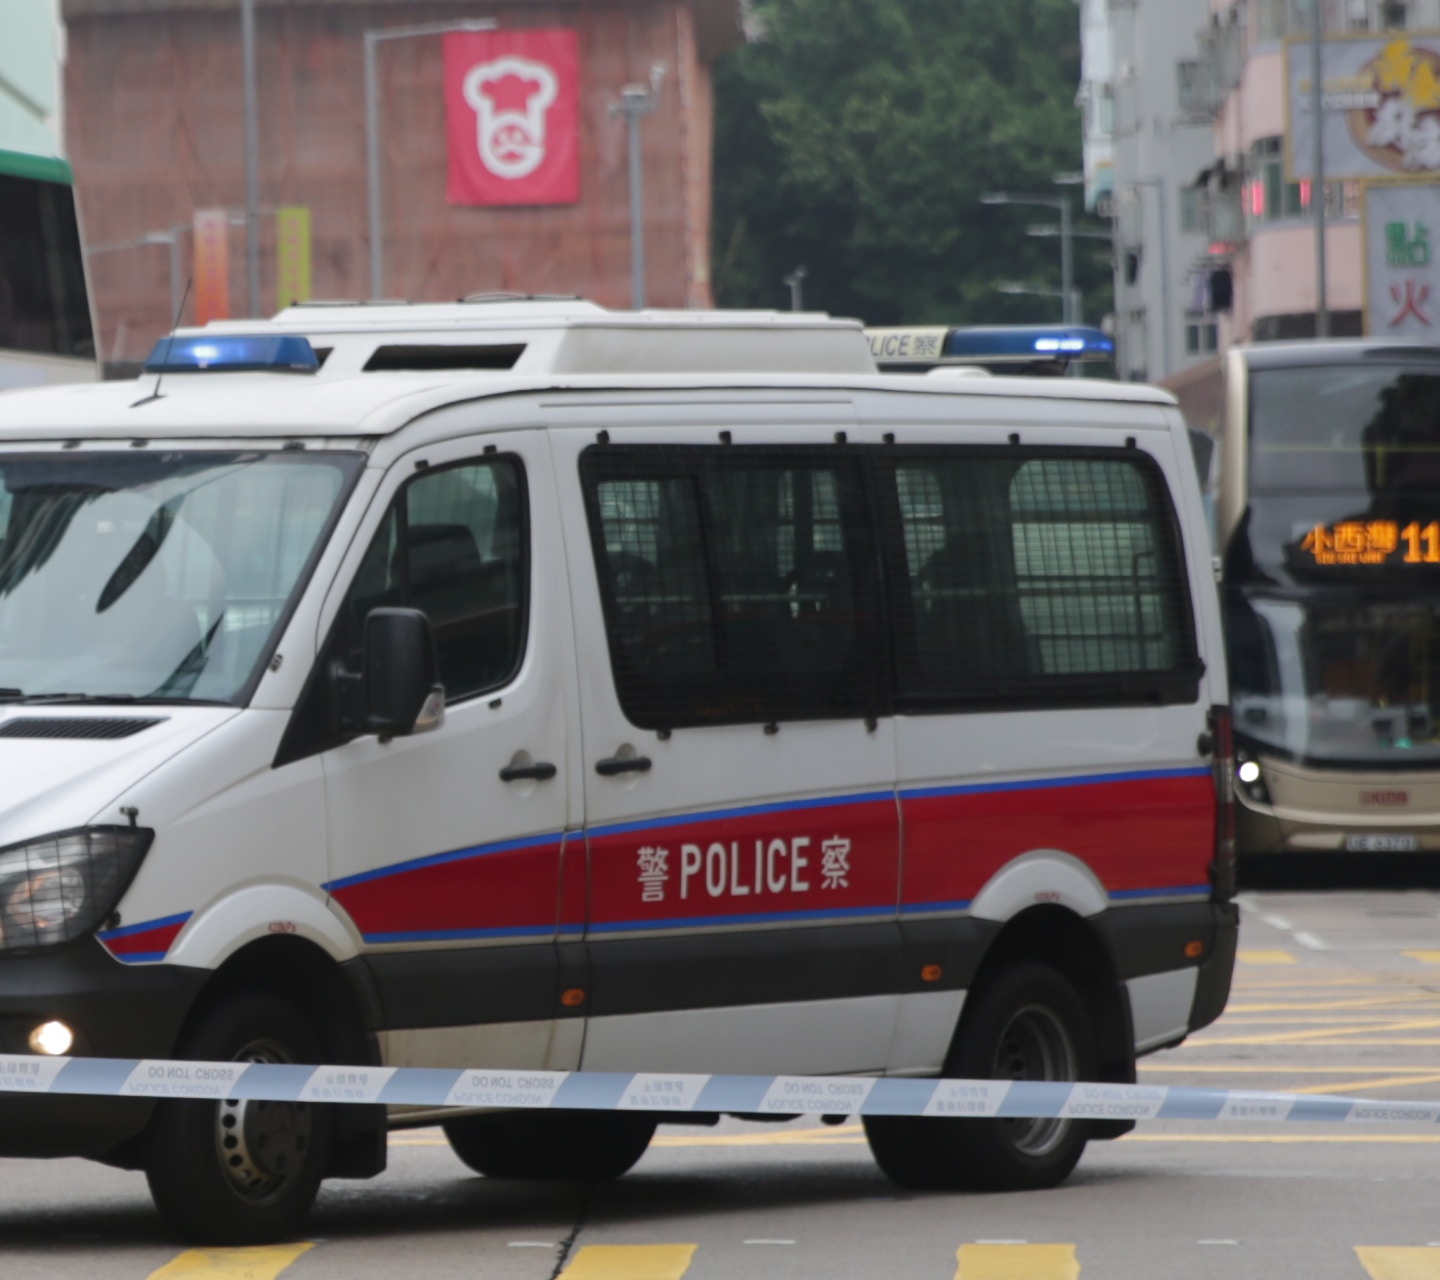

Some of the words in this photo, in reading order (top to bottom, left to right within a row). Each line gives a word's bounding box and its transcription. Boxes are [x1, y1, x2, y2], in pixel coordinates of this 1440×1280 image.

[1300, 520, 1399, 554] 小西灣
[636, 845, 669, 902] 警
[680, 836, 811, 900] POLICE
[821, 834, 851, 889] 察
